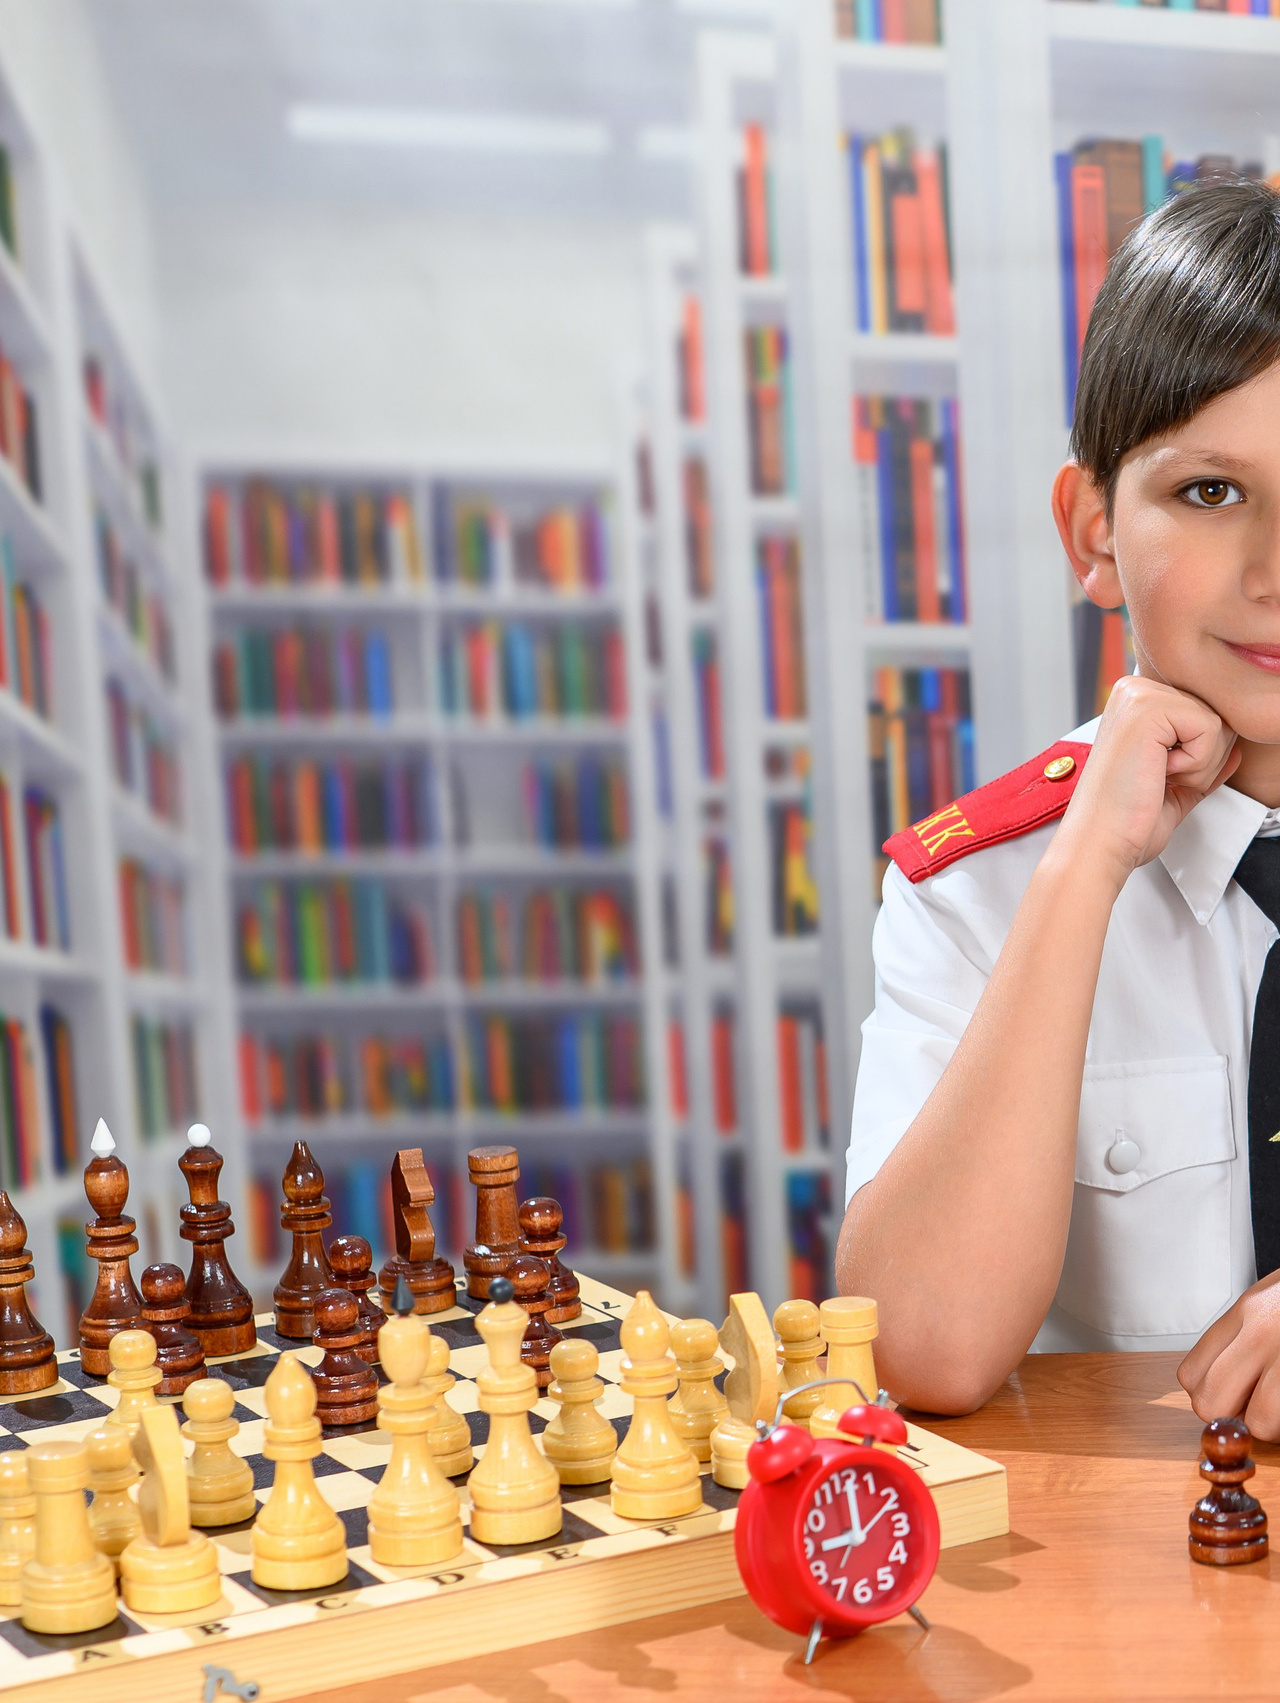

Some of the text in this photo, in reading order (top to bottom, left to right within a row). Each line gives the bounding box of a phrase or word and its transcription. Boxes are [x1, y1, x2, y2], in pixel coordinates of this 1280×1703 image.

[862, 1471, 876, 1495] 1
[880, 1486, 899, 1512] 2
[891, 1512, 911, 1538] 3
[888, 1540, 908, 1566] 4
[830, 1576, 849, 1602] 7
[852, 1577, 874, 1604] 6
[876, 1566, 895, 1592] 5
[81, 1523, 678, 1663] A B C D E F
